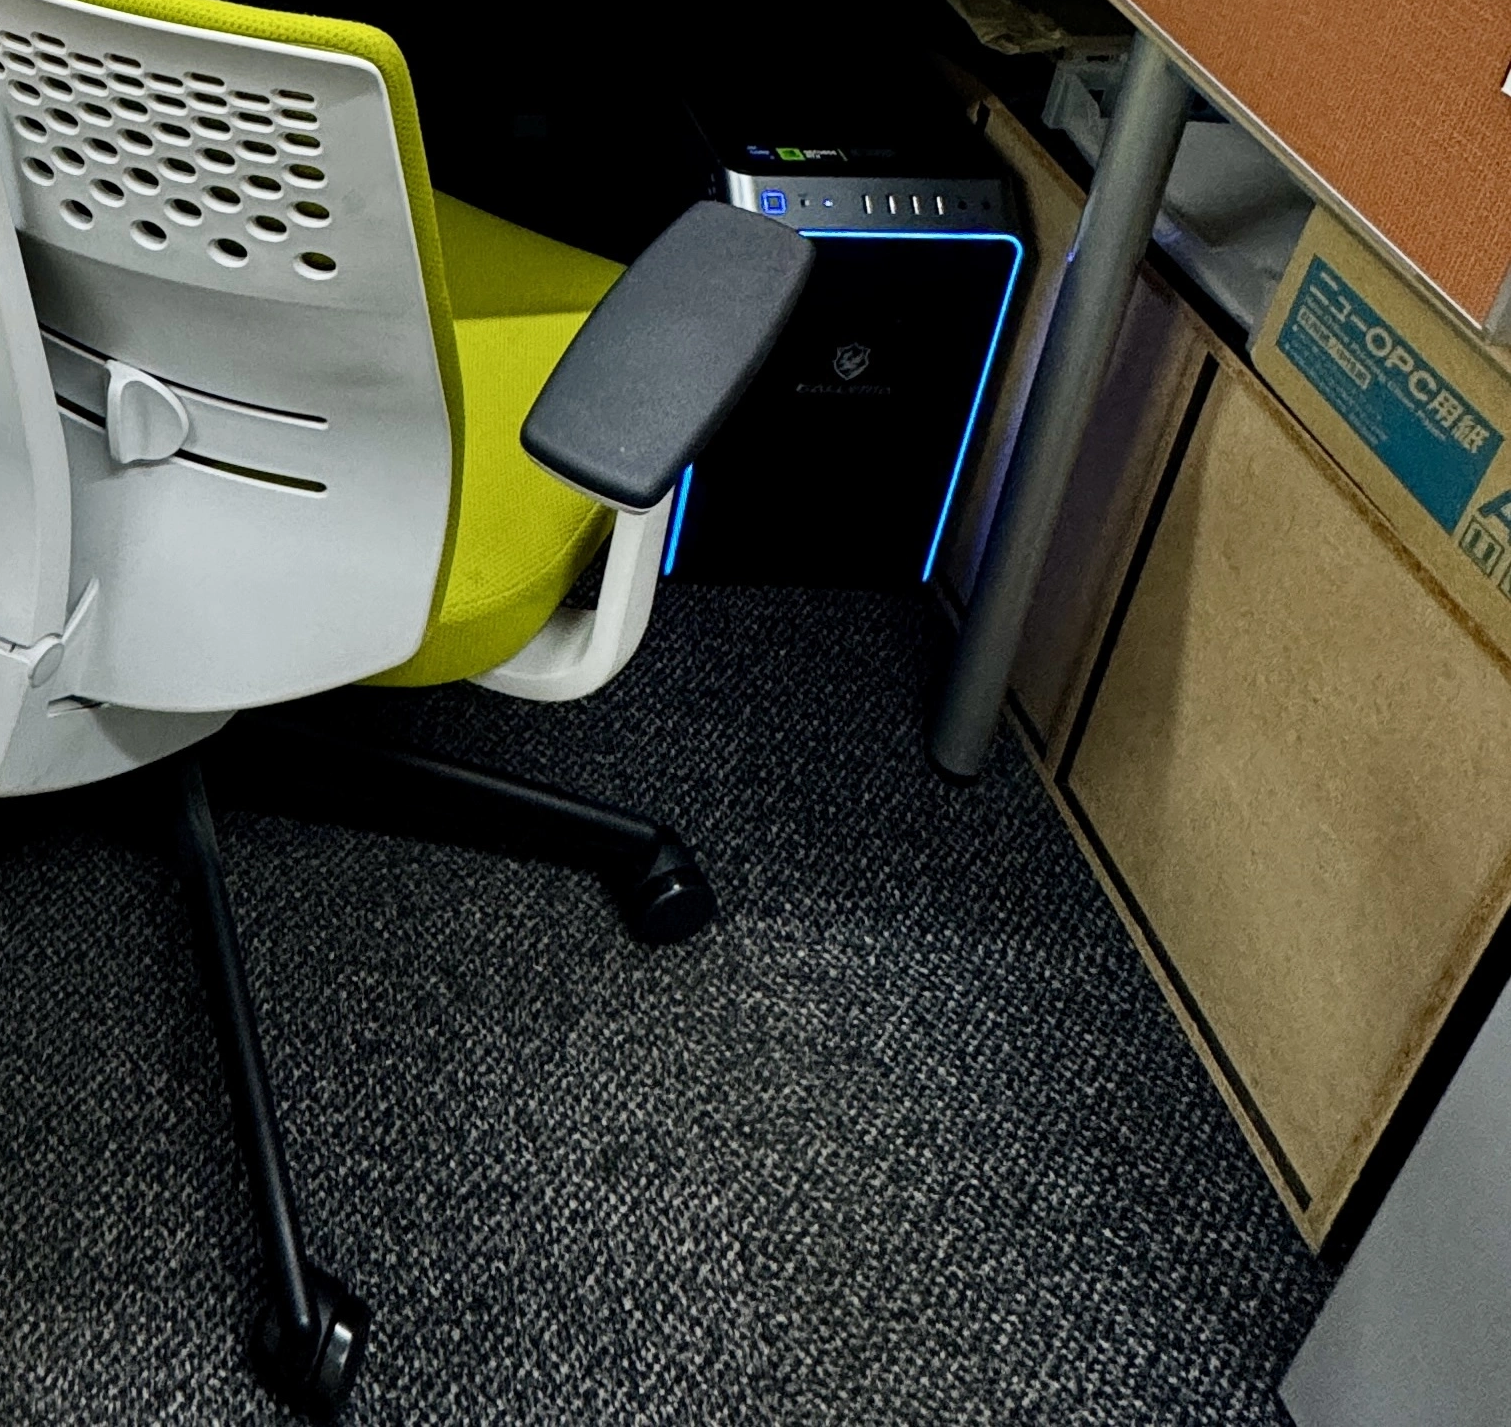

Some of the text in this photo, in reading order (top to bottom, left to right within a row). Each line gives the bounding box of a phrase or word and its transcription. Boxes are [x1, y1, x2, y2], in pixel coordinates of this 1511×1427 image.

[1310, 272, 1490, 453] ニューOPC用紙
